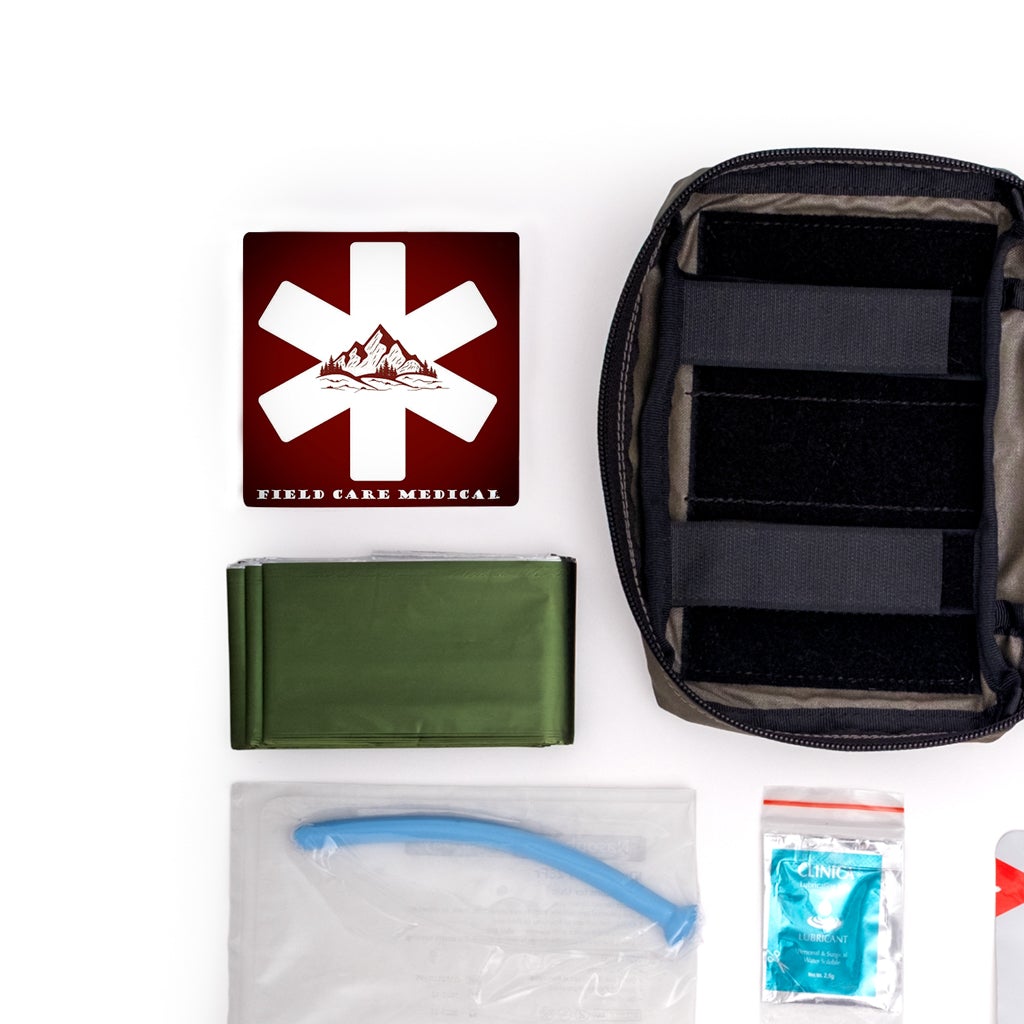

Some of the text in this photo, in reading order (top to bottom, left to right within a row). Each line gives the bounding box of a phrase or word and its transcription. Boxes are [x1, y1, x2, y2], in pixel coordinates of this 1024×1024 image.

[256, 489, 500, 499] FIELD CARE MEDICAL
[799, 934, 848, 943] LUBRICANT
